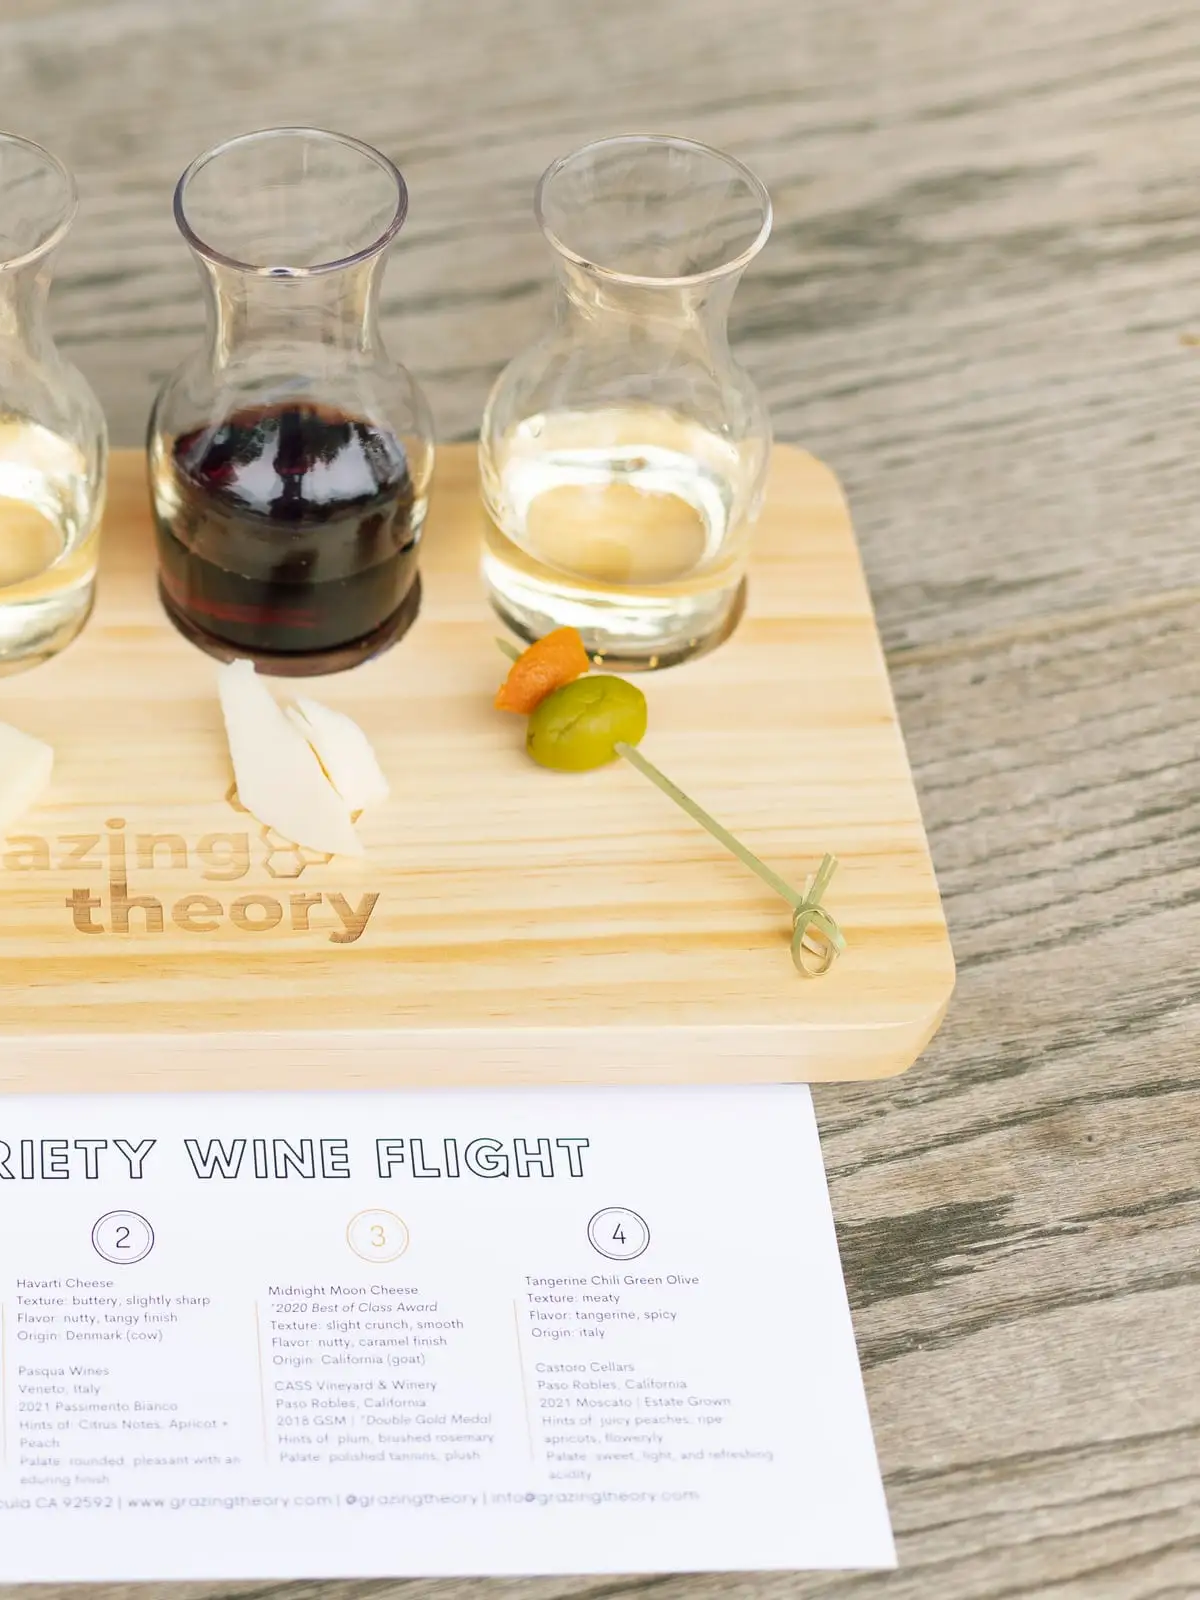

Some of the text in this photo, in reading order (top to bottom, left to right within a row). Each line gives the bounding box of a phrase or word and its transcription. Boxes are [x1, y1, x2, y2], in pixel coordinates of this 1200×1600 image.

[66, 881, 380, 944] theory
[184, 1138, 350, 1179] WINE
[376, 1137, 590, 1178] FLIGHT
[115, 1226, 131, 1249] 2
[370, 1225, 386, 1247] 3
[611, 1222, 627, 1245] 4
[16, 1277, 114, 1289] Havarti Cheese
[524, 1274, 700, 1289] Tangerine Chili Green Olive
[268, 1284, 419, 1299] Midnight Moon Cheese
[125, 1294, 172, 1309] slightly
[175, 1294, 211, 1308] sharp
[582, 1293, 621, 1305] meaty
[311, 1302, 339, 1313] Best
[341, 1301, 356, 1313] of
[357, 1301, 393, 1314] Class
[395, 1301, 438, 1312] Award
[104, 1313, 140, 1326] tangy
[143, 1311, 178, 1323] finish
[575, 1310, 641, 1323] tangerine,
[643, 1308, 678, 1323] spicy
[326, 1319, 361, 1334] slight
[416, 1318, 464, 1330] smooth
[65, 1329, 123, 1341] Denmark
[125, 1327, 164, 1344] (cow)
[358, 1335, 410, 1348] caramel
[412, 1335, 448, 1347] finish
[320, 1353, 384, 1366] California
[386, 1351, 426, 1367] (goat)
[18, 1365, 110, 1379] Pasqua Wines
[589, 1360, 636, 1373] Cellars
[73, 1383, 101, 1397] Italy
[274, 1379, 313, 1392] CASS
[316, 1379, 374, 1394] Vineyard
[391, 1379, 437, 1393] Winery
[535, 1379, 570, 1391] Paso
[624, 1377, 689, 1390] California
[18, 1400, 50, 1413] 2021
[133, 1400, 179, 1412] Bianco
[275, 1398, 308, 1410] Paso
[363, 1396, 427, 1409] California
[539, 1395, 732, 1409] 2021 Moscato Estate Grown
[18, 1420, 54, 1431] Hints
[312, 1415, 347, 1426] GSM
[414, 1413, 447, 1426] Gold
[450, 1412, 492, 1425] Medal
[541, 1415, 576, 1427] Hints
[277, 1433, 313, 1445] Hints
